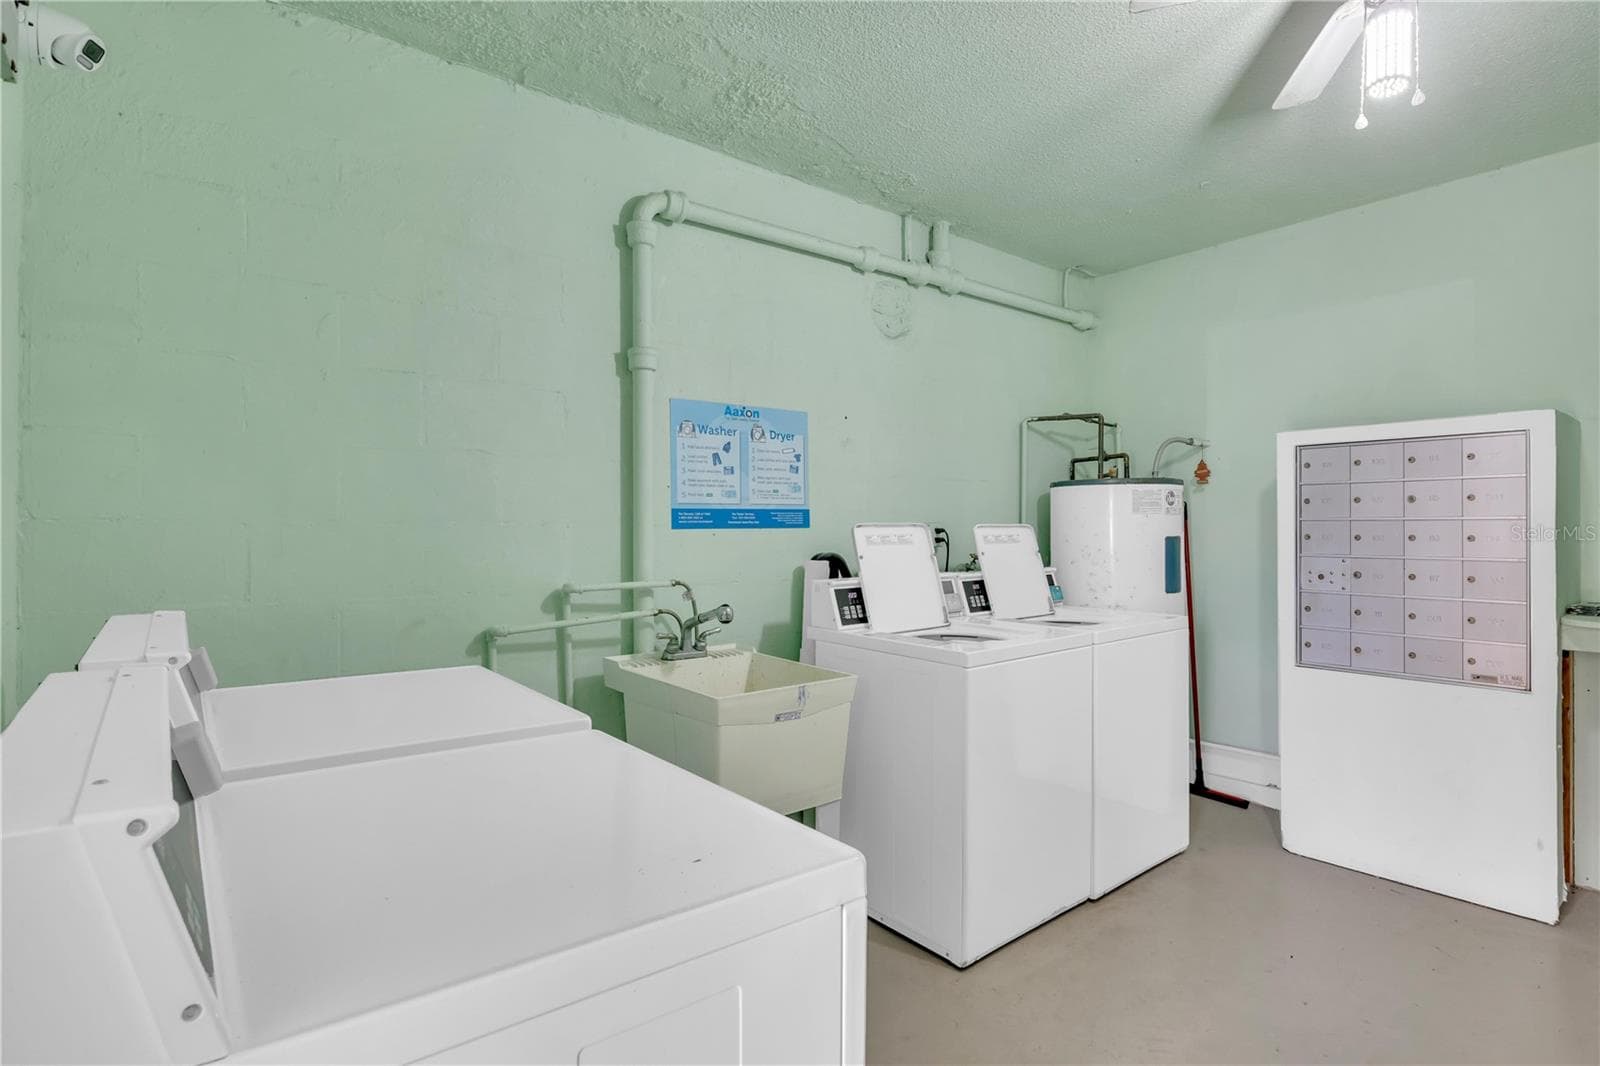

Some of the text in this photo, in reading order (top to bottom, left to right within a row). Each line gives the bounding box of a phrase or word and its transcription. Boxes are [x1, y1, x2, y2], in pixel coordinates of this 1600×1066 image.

[724, 405, 760, 418] Aaxon
[697, 424, 738, 438] Washer
[769, 430, 795, 442] Dryer
